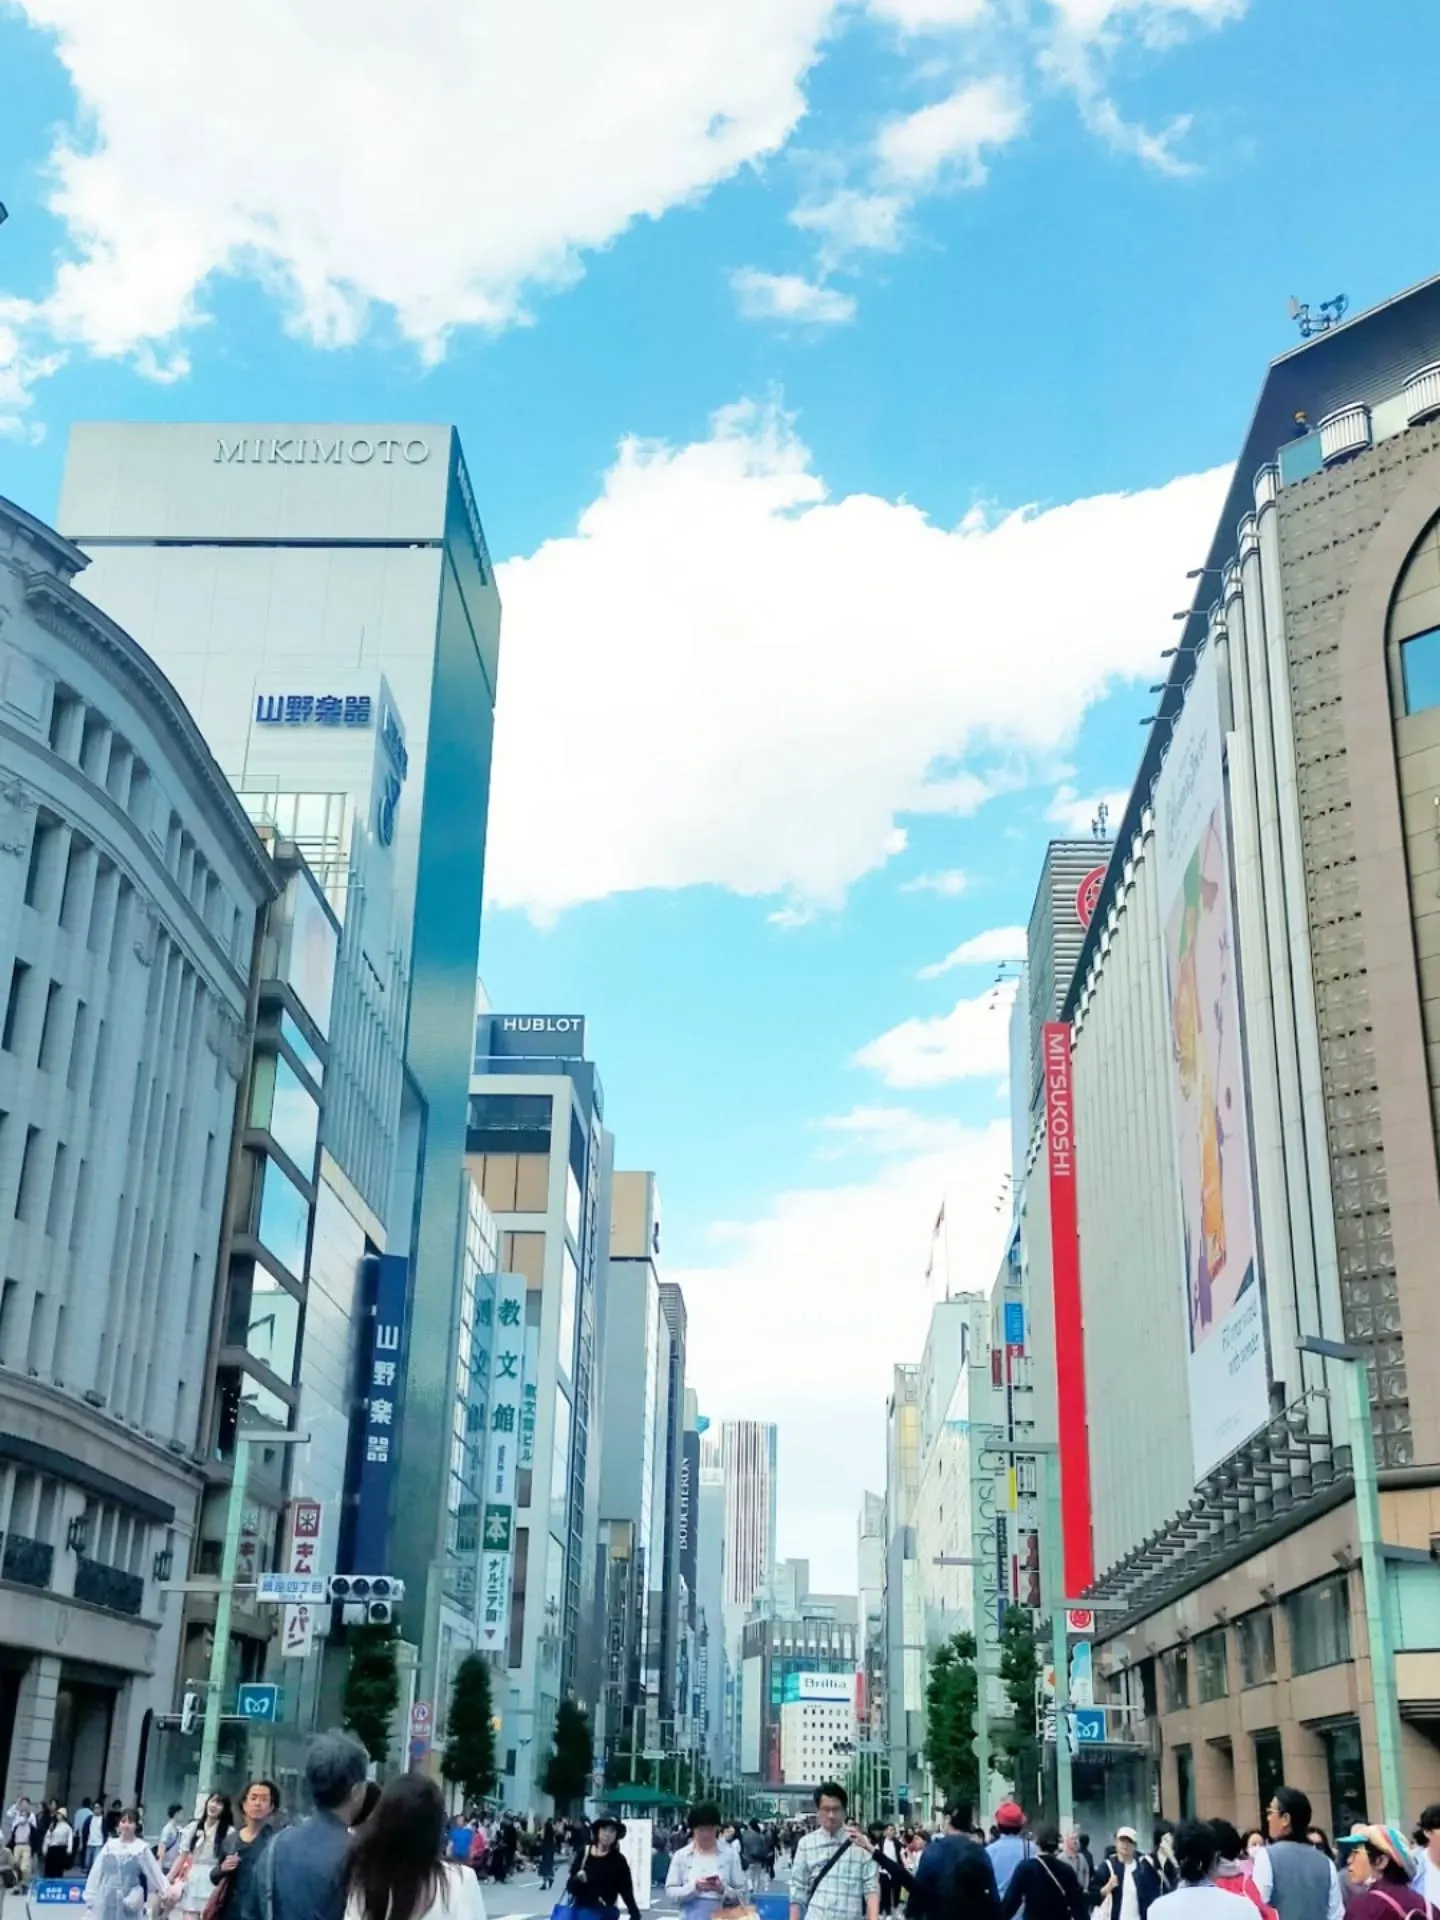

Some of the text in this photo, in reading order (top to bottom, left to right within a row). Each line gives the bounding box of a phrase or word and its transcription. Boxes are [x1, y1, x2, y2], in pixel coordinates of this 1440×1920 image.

[213, 438, 431, 466] MIKIMOTO
[255, 694, 373, 726] 山野楽器
[503, 1017, 581, 1032] HUBLOT
[1047, 1032, 1071, 1178] MITSUKOSHI
[491, 1297, 521, 1433] 教文館
[366, 1324, 400, 1463] 山野楽器
[485, 1513, 511, 1542] 本
[804, 1676, 848, 1689] Brillia
